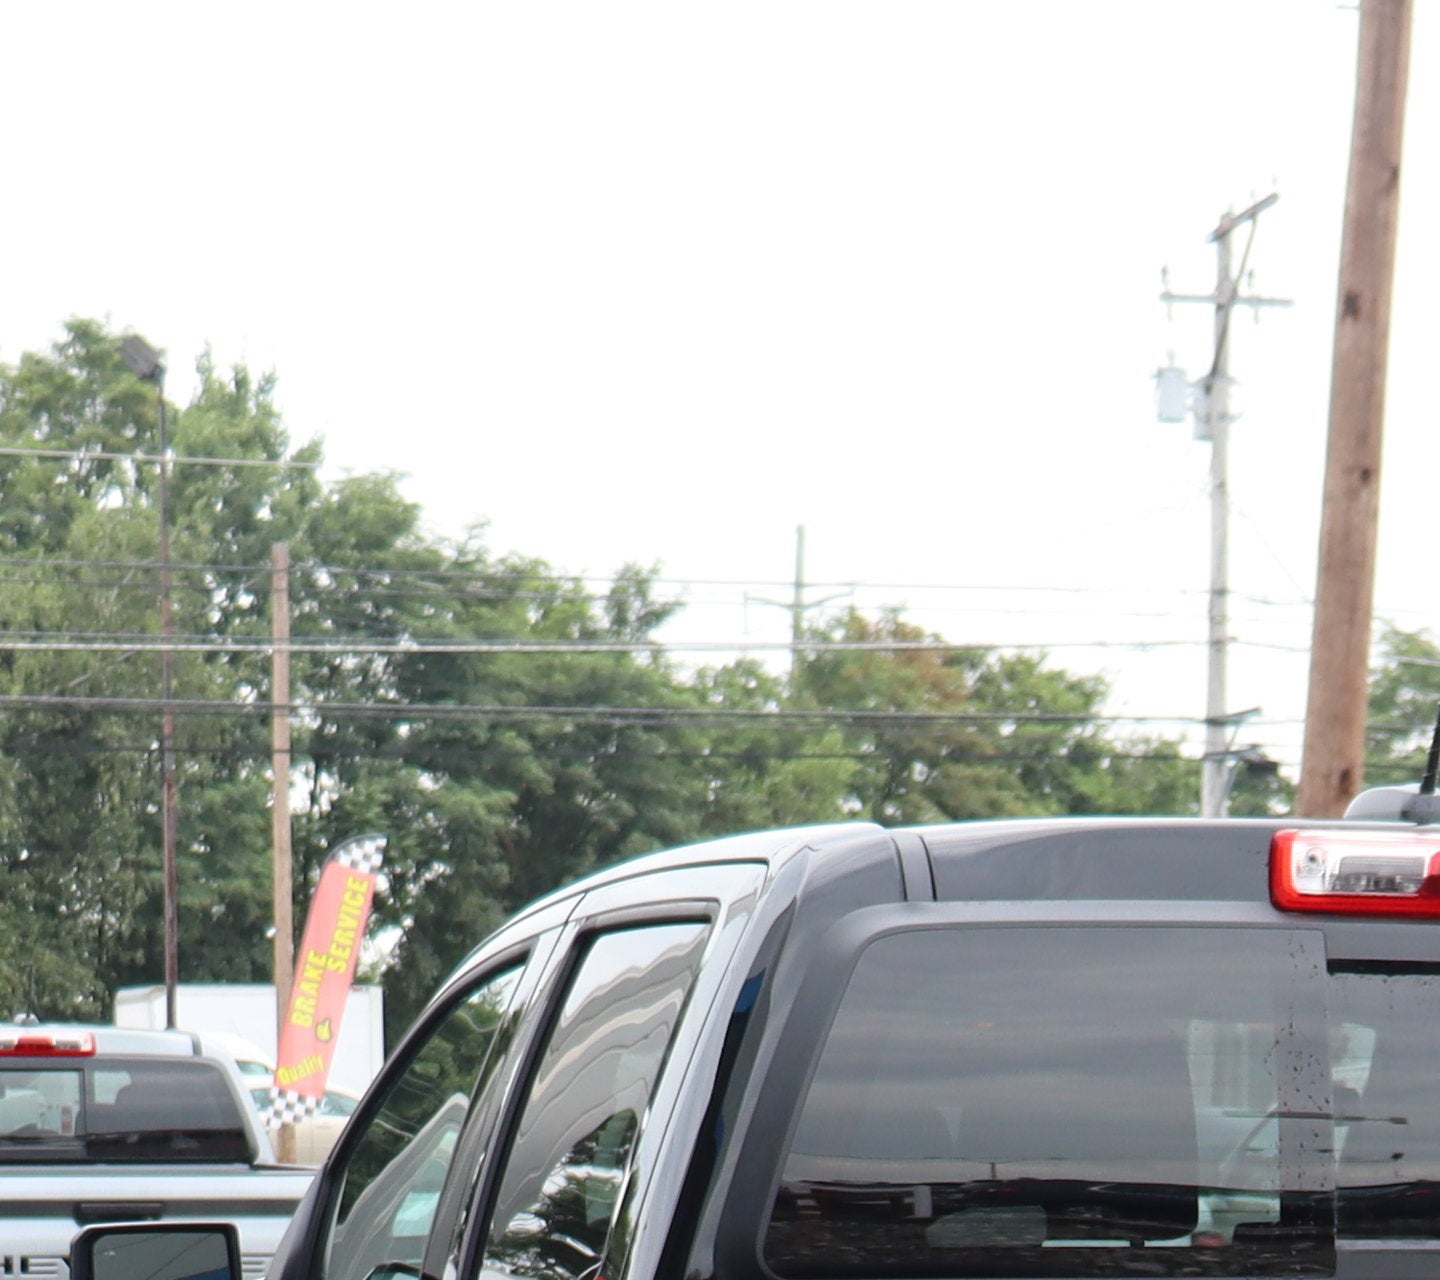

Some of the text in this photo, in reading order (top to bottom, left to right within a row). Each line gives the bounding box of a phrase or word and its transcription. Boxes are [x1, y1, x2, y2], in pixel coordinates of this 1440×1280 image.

[326, 875, 370, 974] SERVICE
[290, 949, 329, 1028] BRAKE
[278, 1053, 325, 1087] Quality
